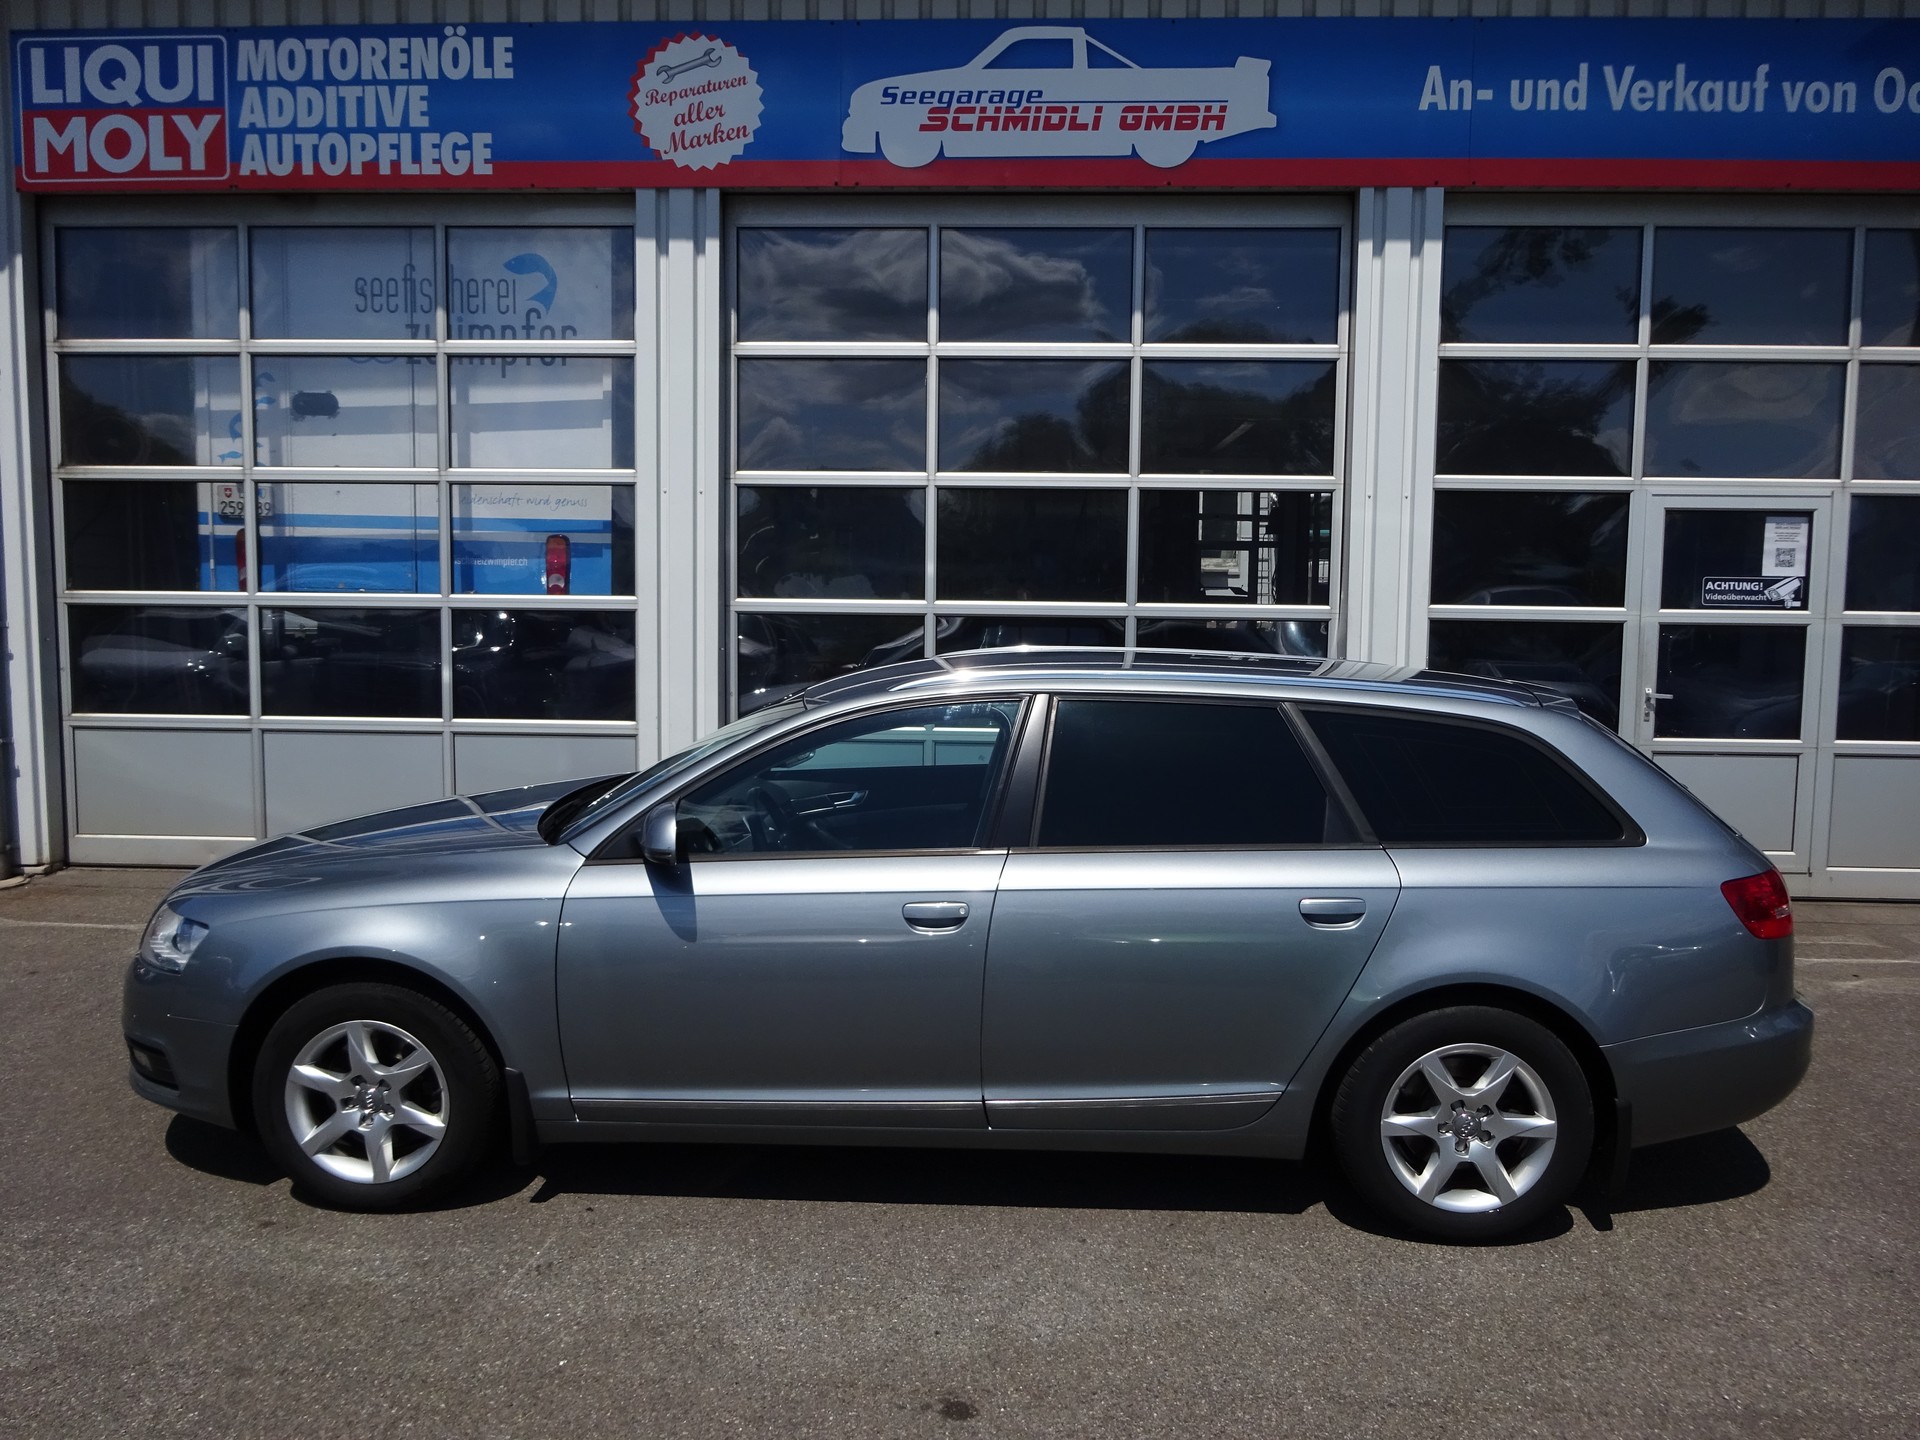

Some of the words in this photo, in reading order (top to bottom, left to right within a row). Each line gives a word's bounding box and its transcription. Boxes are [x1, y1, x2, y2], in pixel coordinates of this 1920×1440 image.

[237, 25, 513, 81] MOTORENÖLE
[31, 44, 214, 107] LIQUI
[645, 75, 748, 106] Reparaturen
[880, 86, 1044, 108] Seegarage
[1418, 65, 1493, 111] An-
[1510, 62, 1589, 111] und
[1603, 62, 1770, 112] Verkauf
[1782, 79, 1857, 113] von
[238, 85, 430, 128] ADDITIVE
[673, 100, 726, 127] aller
[919, 106, 1103, 132] SCHMIDLI
[1118, 105, 1229, 131] GMBH
[33, 114, 222, 173] MOLY
[239, 131, 493, 176] AUTOPFLEGE
[664, 122, 750, 154] Marken
[355, 263, 517, 315] seefisherei
[1705, 581, 1764, 591] ACHTUNG!
